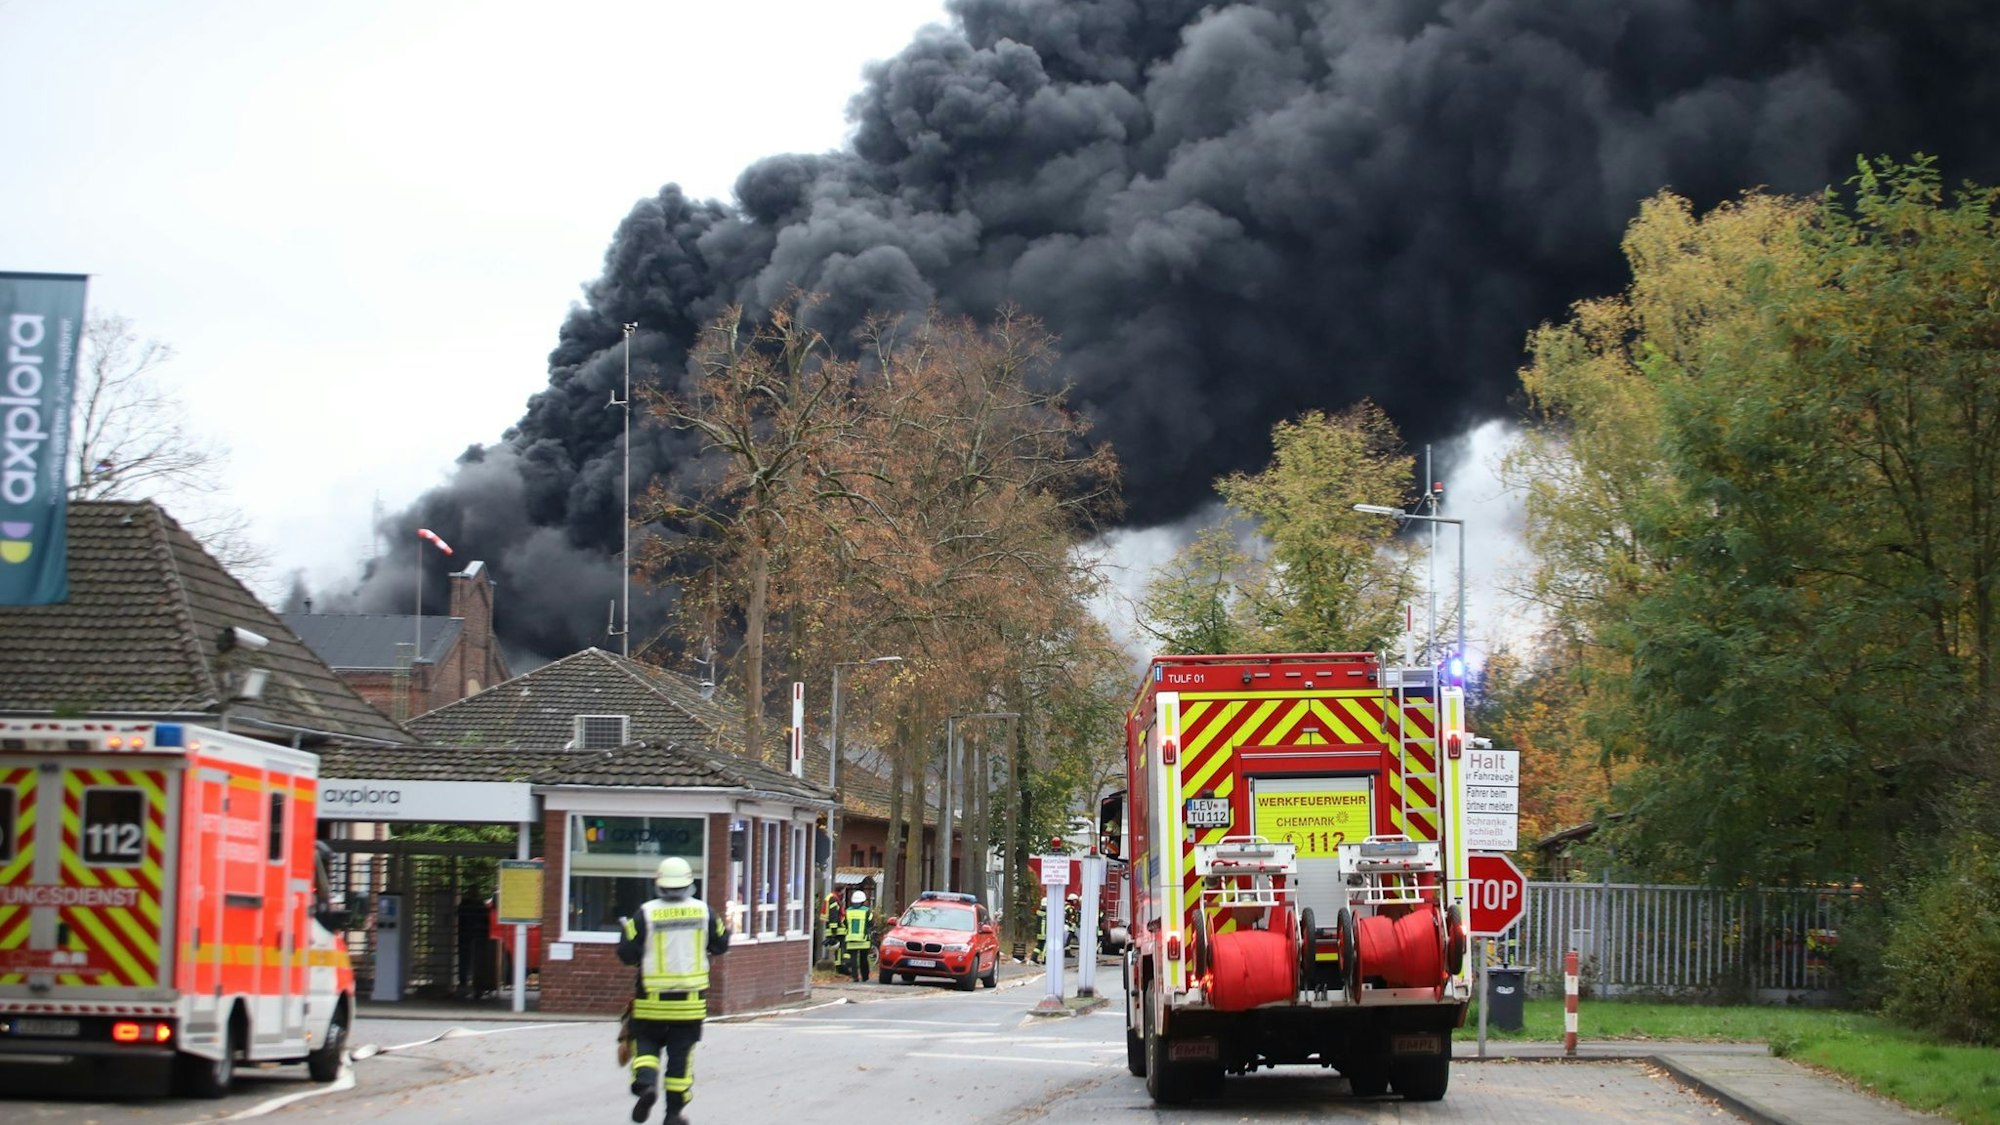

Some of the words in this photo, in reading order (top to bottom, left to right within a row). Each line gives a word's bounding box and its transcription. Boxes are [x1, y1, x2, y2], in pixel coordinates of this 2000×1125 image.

[0, 313, 48, 504] axplora
[1168, 674, 1192, 683] TULF
[1194, 674, 1205, 683] 01
[1470, 753, 1506, 769] Halt
[1473, 771, 1514, 782] Fahrzeuge
[324, 786, 400, 807] axplora
[1467, 787, 1489, 797] Fahrer
[1490, 789, 1508, 798] beim
[1193, 800, 1214, 811] LEV
[1258, 795, 1367, 806] WERKFEUERWEHR
[1467, 801, 1487, 810] örtner
[1489, 802, 1514, 811] melden
[1191, 811, 1205, 822] TU
[1206, 811, 1226, 822] 112
[1276, 817, 1335, 827] CHEMPARK
[1466, 817, 1507, 826] Schranke
[1469, 828, 1503, 836] schließt
[87, 823, 142, 854] 112
[1307, 831, 1346, 853] 112
[1467, 839, 1513, 847] tomatisch
[1469, 879, 1518, 910] TOP
